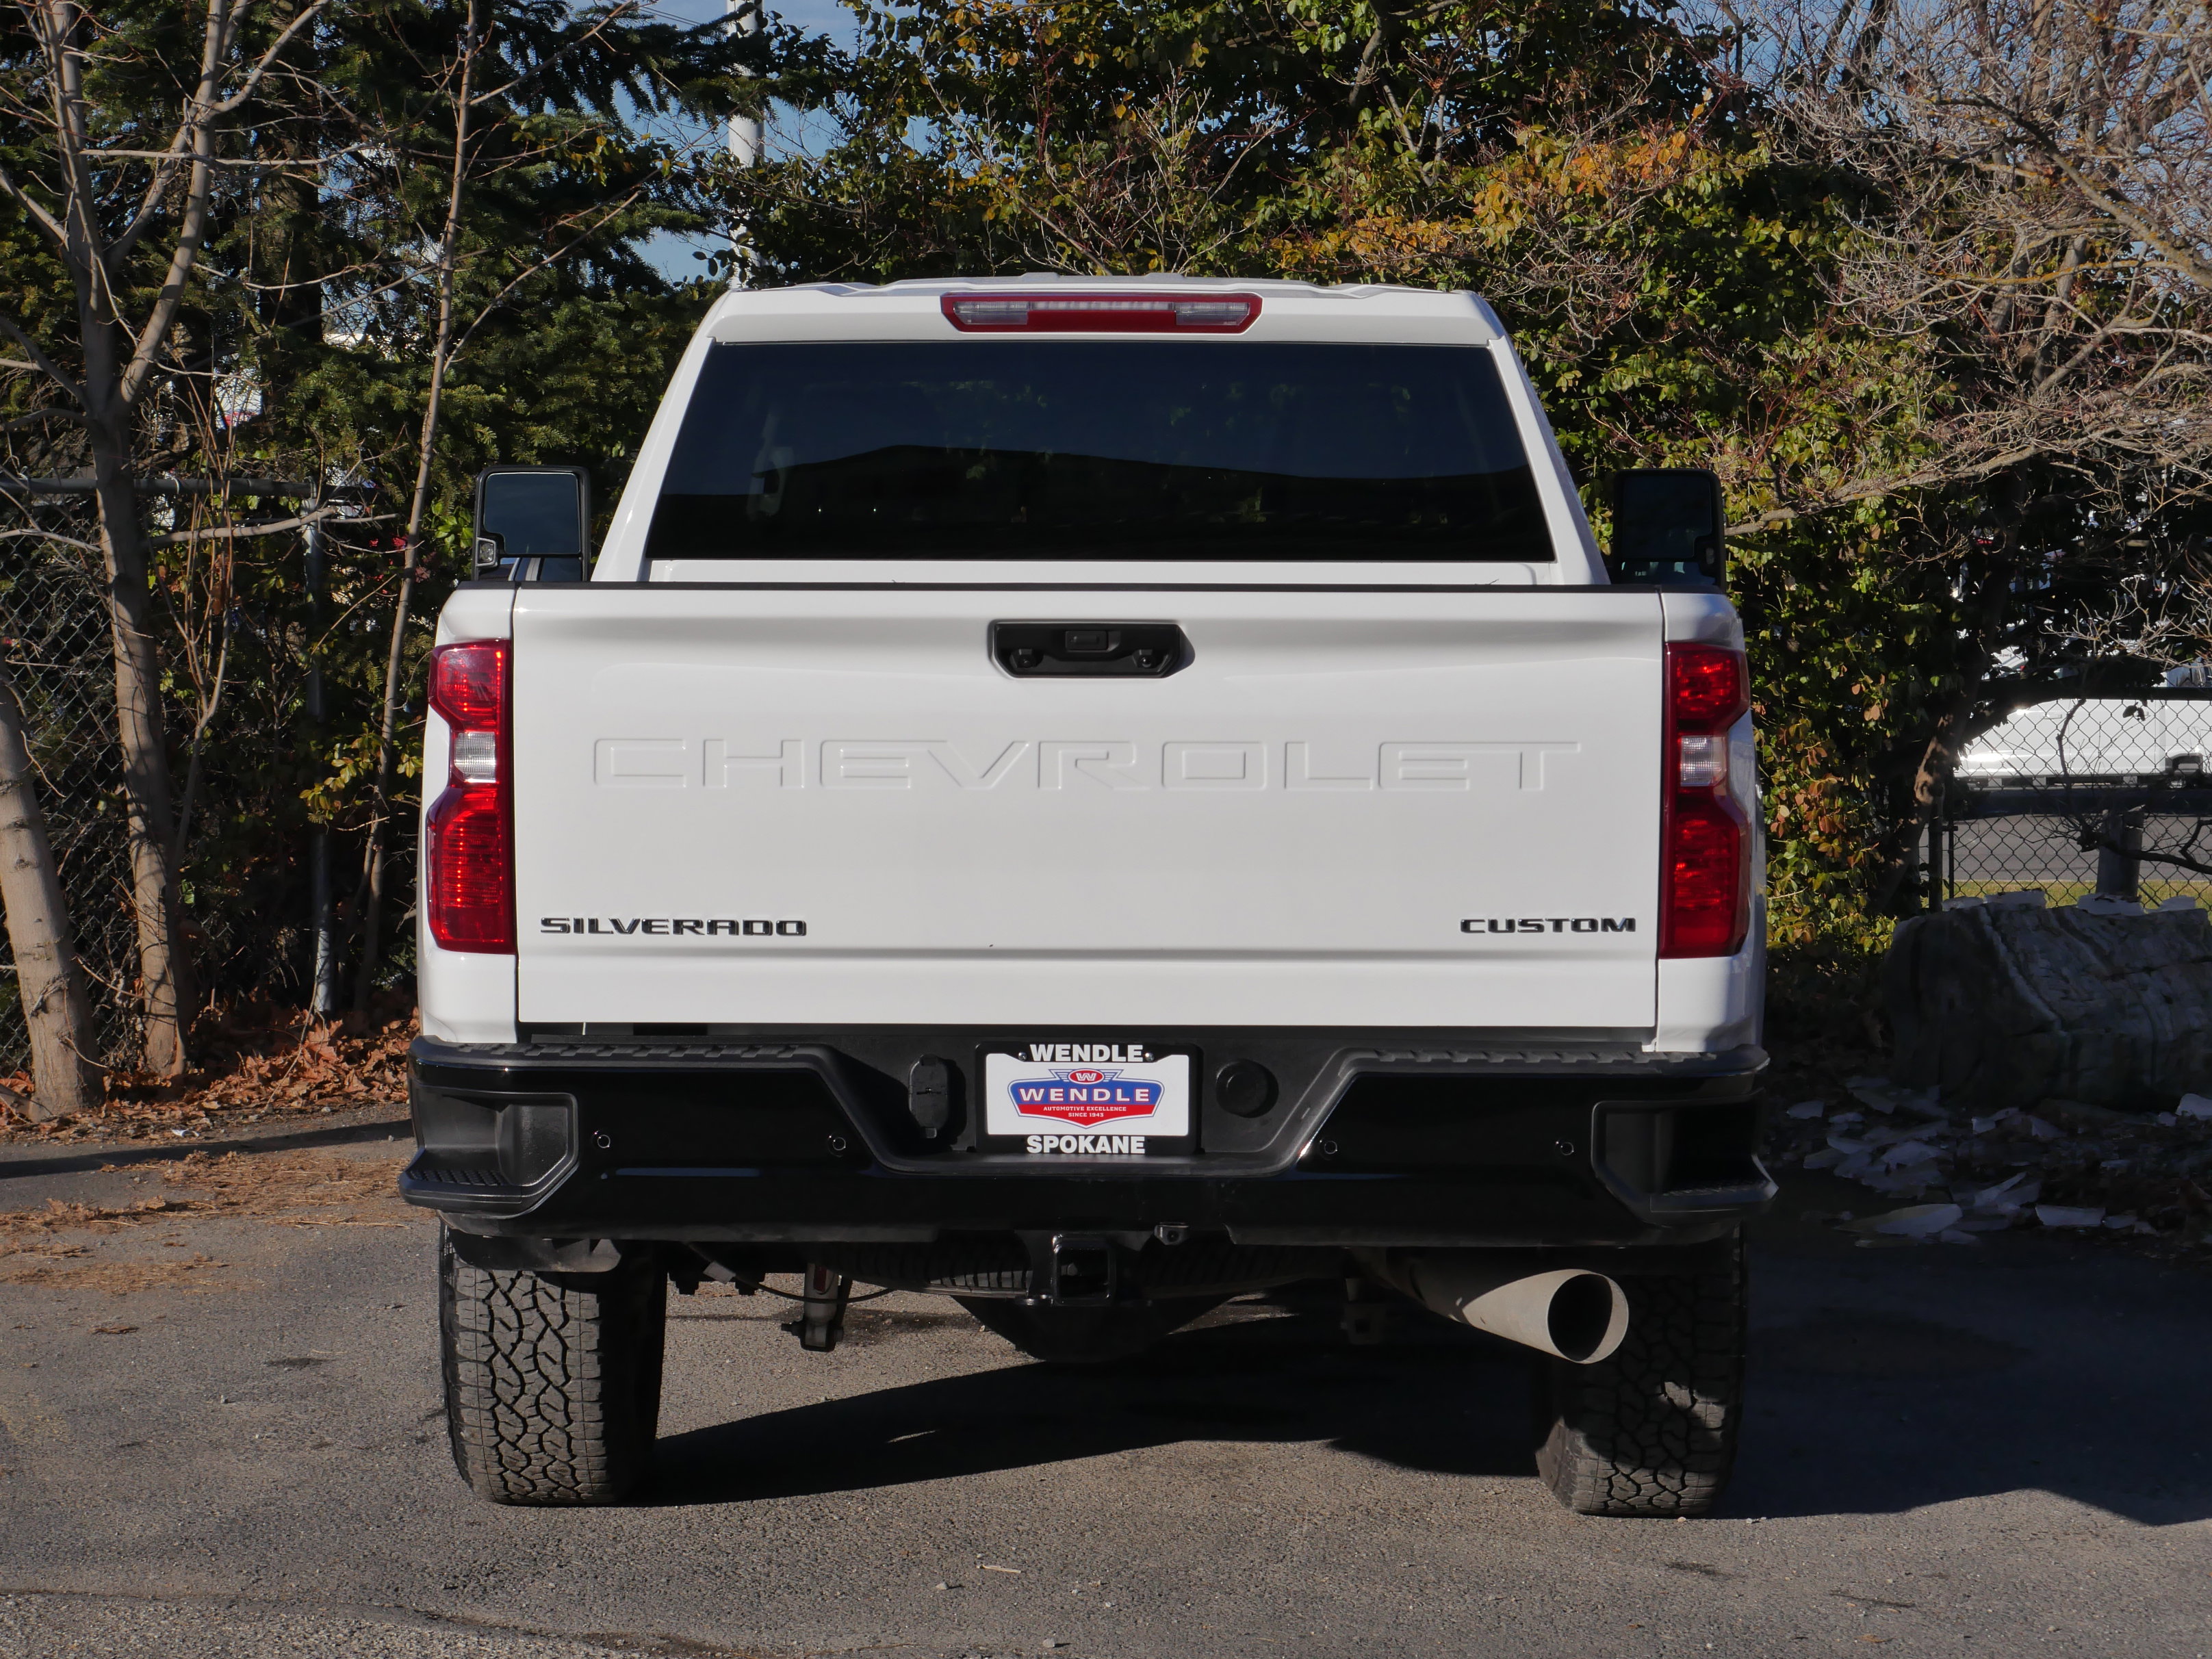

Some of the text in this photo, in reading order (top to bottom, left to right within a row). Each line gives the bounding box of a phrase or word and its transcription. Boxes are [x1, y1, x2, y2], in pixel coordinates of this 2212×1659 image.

[594, 738, 1581, 791] CHEVROLET
[541, 917, 807, 936] SILVERADO
[1460, 918, 1636, 934] CUSTOM
[1029, 1044, 1144, 1062] WENDLE
[1018, 1088, 1150, 1102] WENDLE
[1027, 1135, 1146, 1154] SPOKANE
